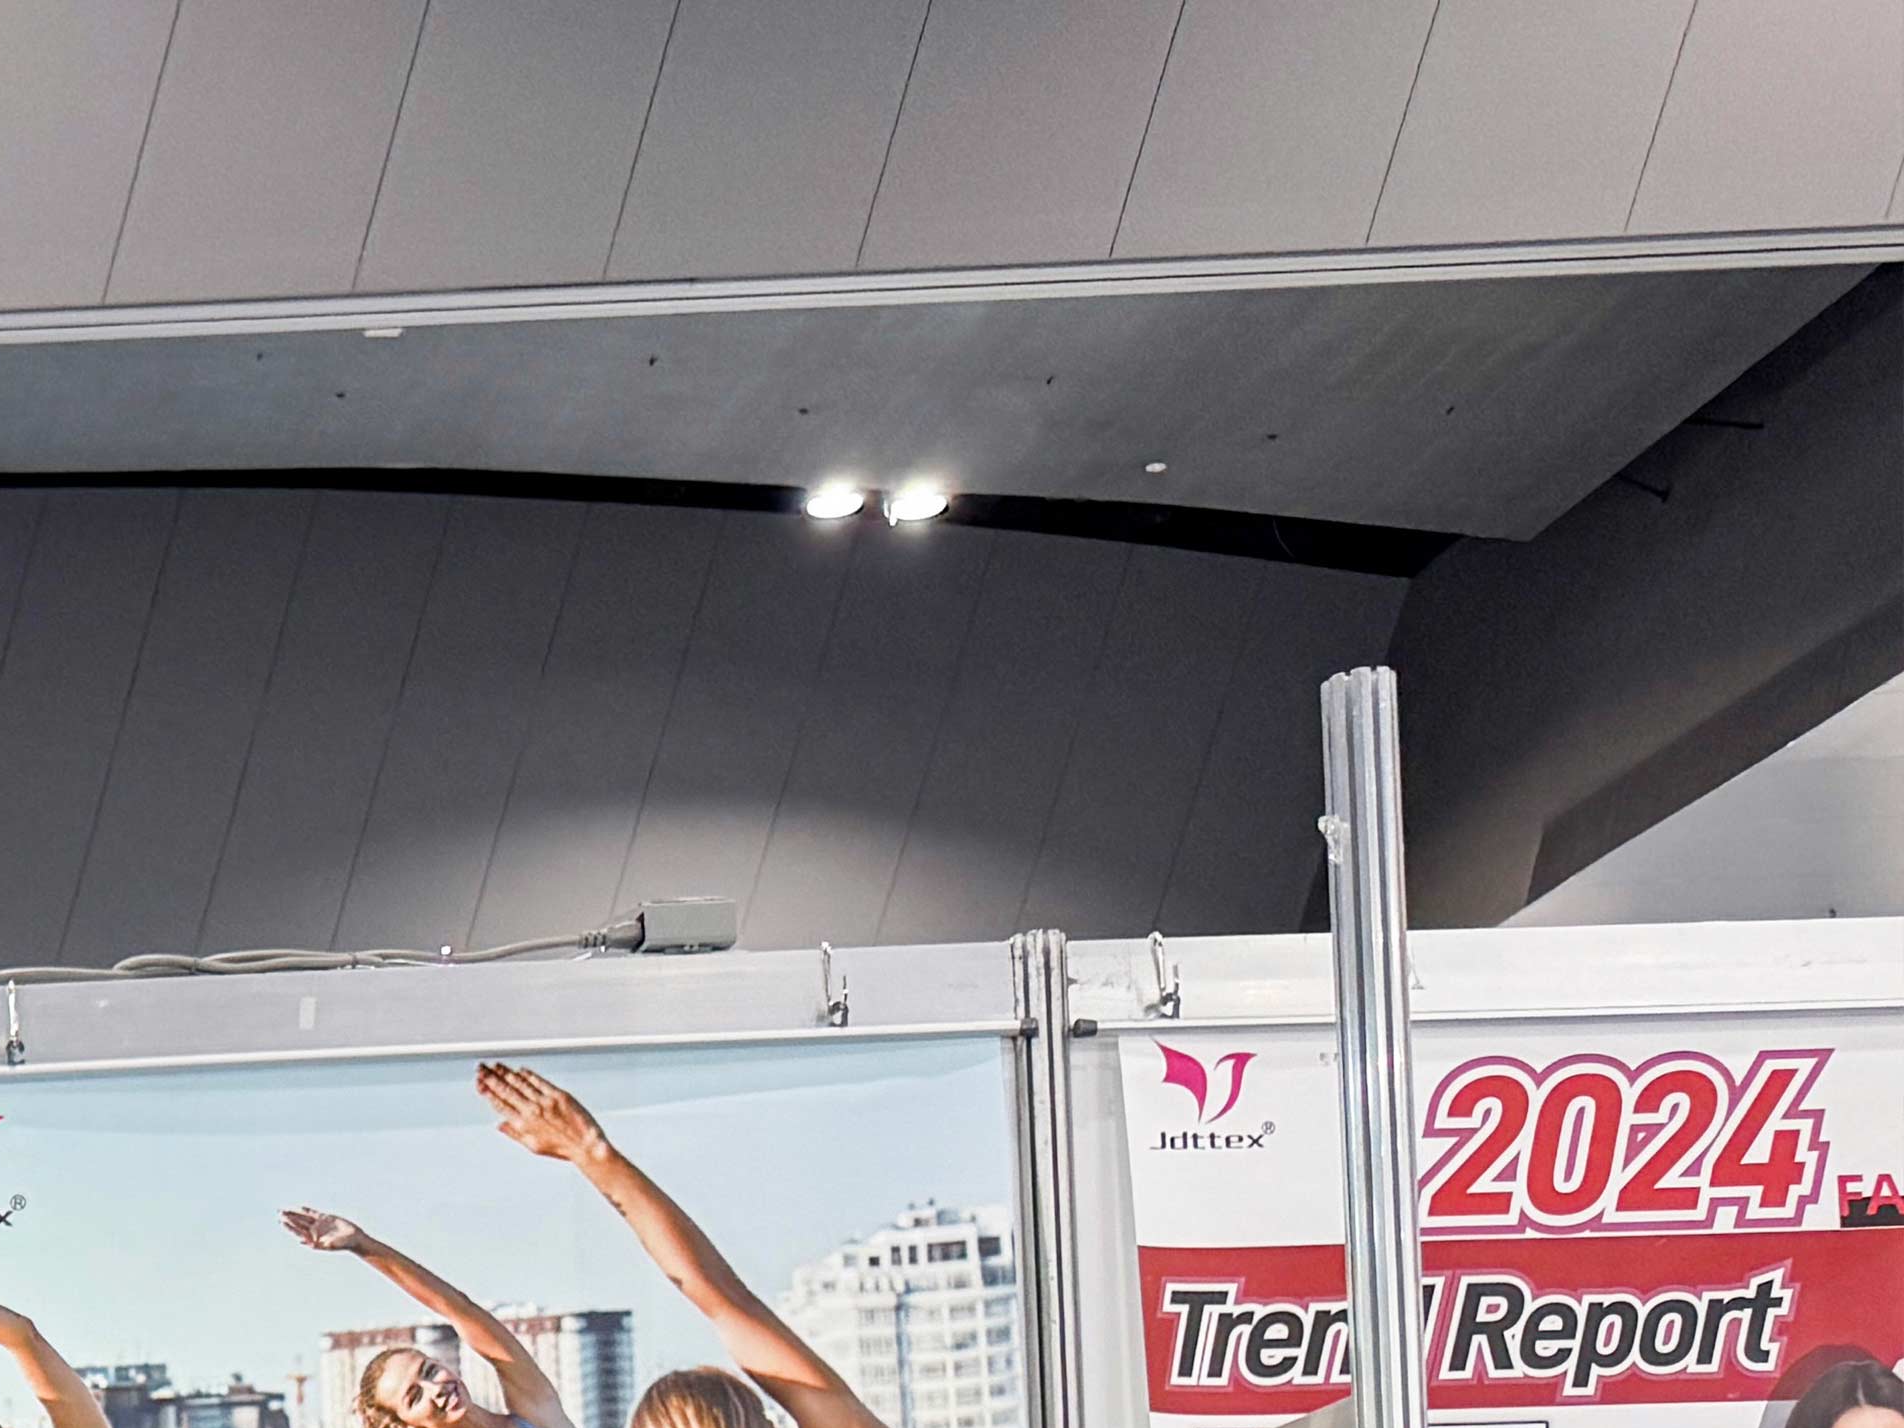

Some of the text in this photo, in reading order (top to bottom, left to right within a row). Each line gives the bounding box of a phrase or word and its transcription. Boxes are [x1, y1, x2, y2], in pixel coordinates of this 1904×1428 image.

[1420, 1052, 1832, 1234] 2024
[1162, 1266, 1792, 1396] Tren Report
